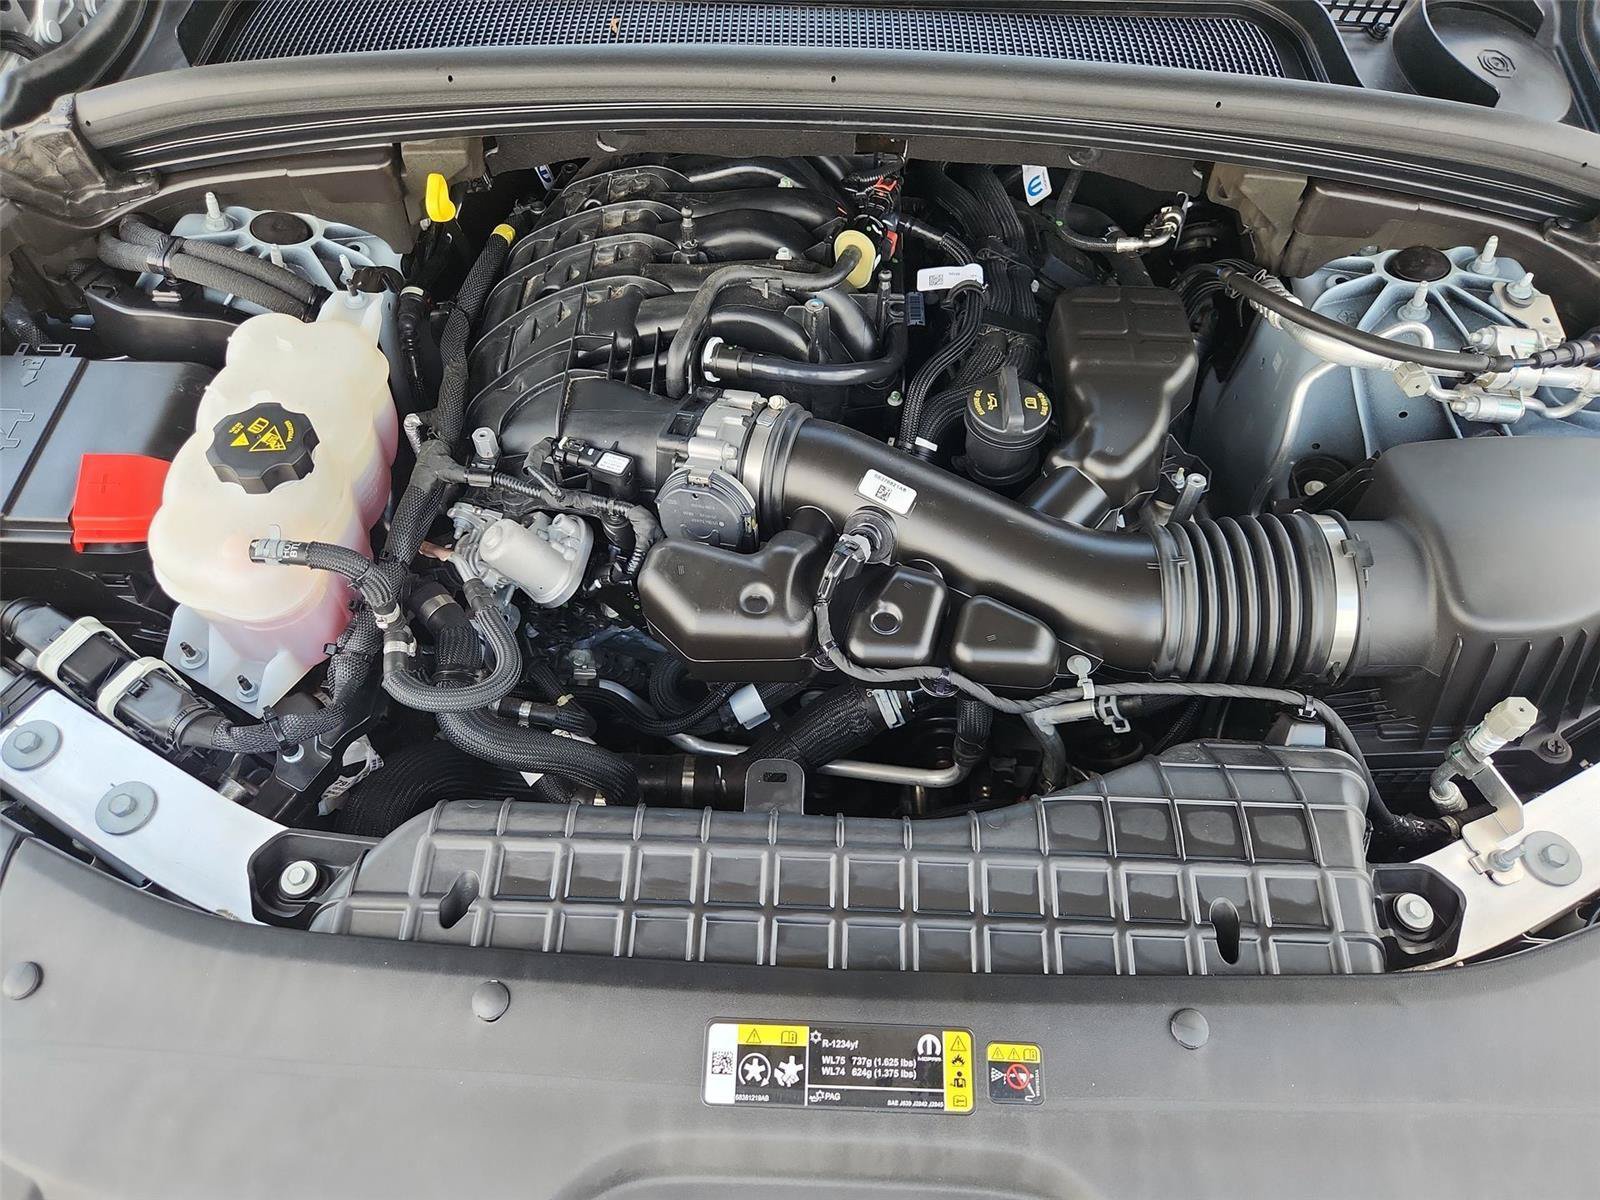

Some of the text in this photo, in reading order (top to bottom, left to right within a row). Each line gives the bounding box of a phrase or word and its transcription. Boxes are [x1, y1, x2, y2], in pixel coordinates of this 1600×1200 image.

[822, 1039, 859, 1050] R-1234yf
[821, 1055, 917, 1069] WL75 737g (1.625 lbs)
[821, 1066, 917, 1080] WL74 624g (1.375 lbs)
[825, 1092, 841, 1101] PAG
